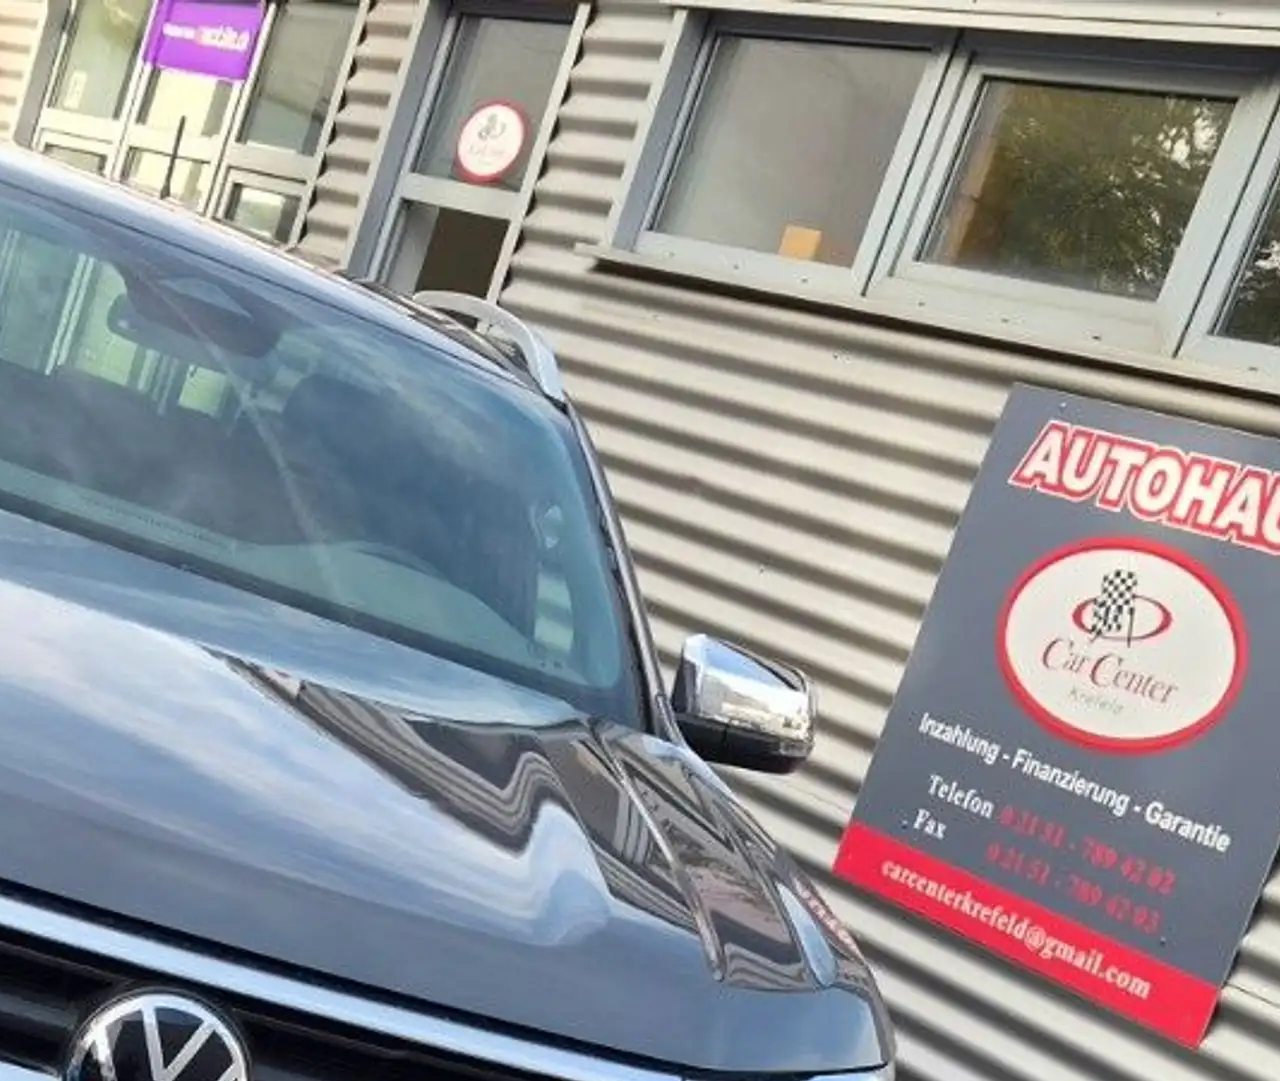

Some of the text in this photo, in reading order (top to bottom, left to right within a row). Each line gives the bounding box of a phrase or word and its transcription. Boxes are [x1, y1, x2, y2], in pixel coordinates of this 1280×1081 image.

[913, 808, 947, 840] Fax
[919, 712, 1001, 765] Inzahlung
[1011, 748, 1130, 817] Finanzierung
[1144, 800, 1231, 852] Garantie
[928, 774, 995, 819] Telefon
[881, 859, 1152, 1000] carcenterkrefeld@gmail.com
